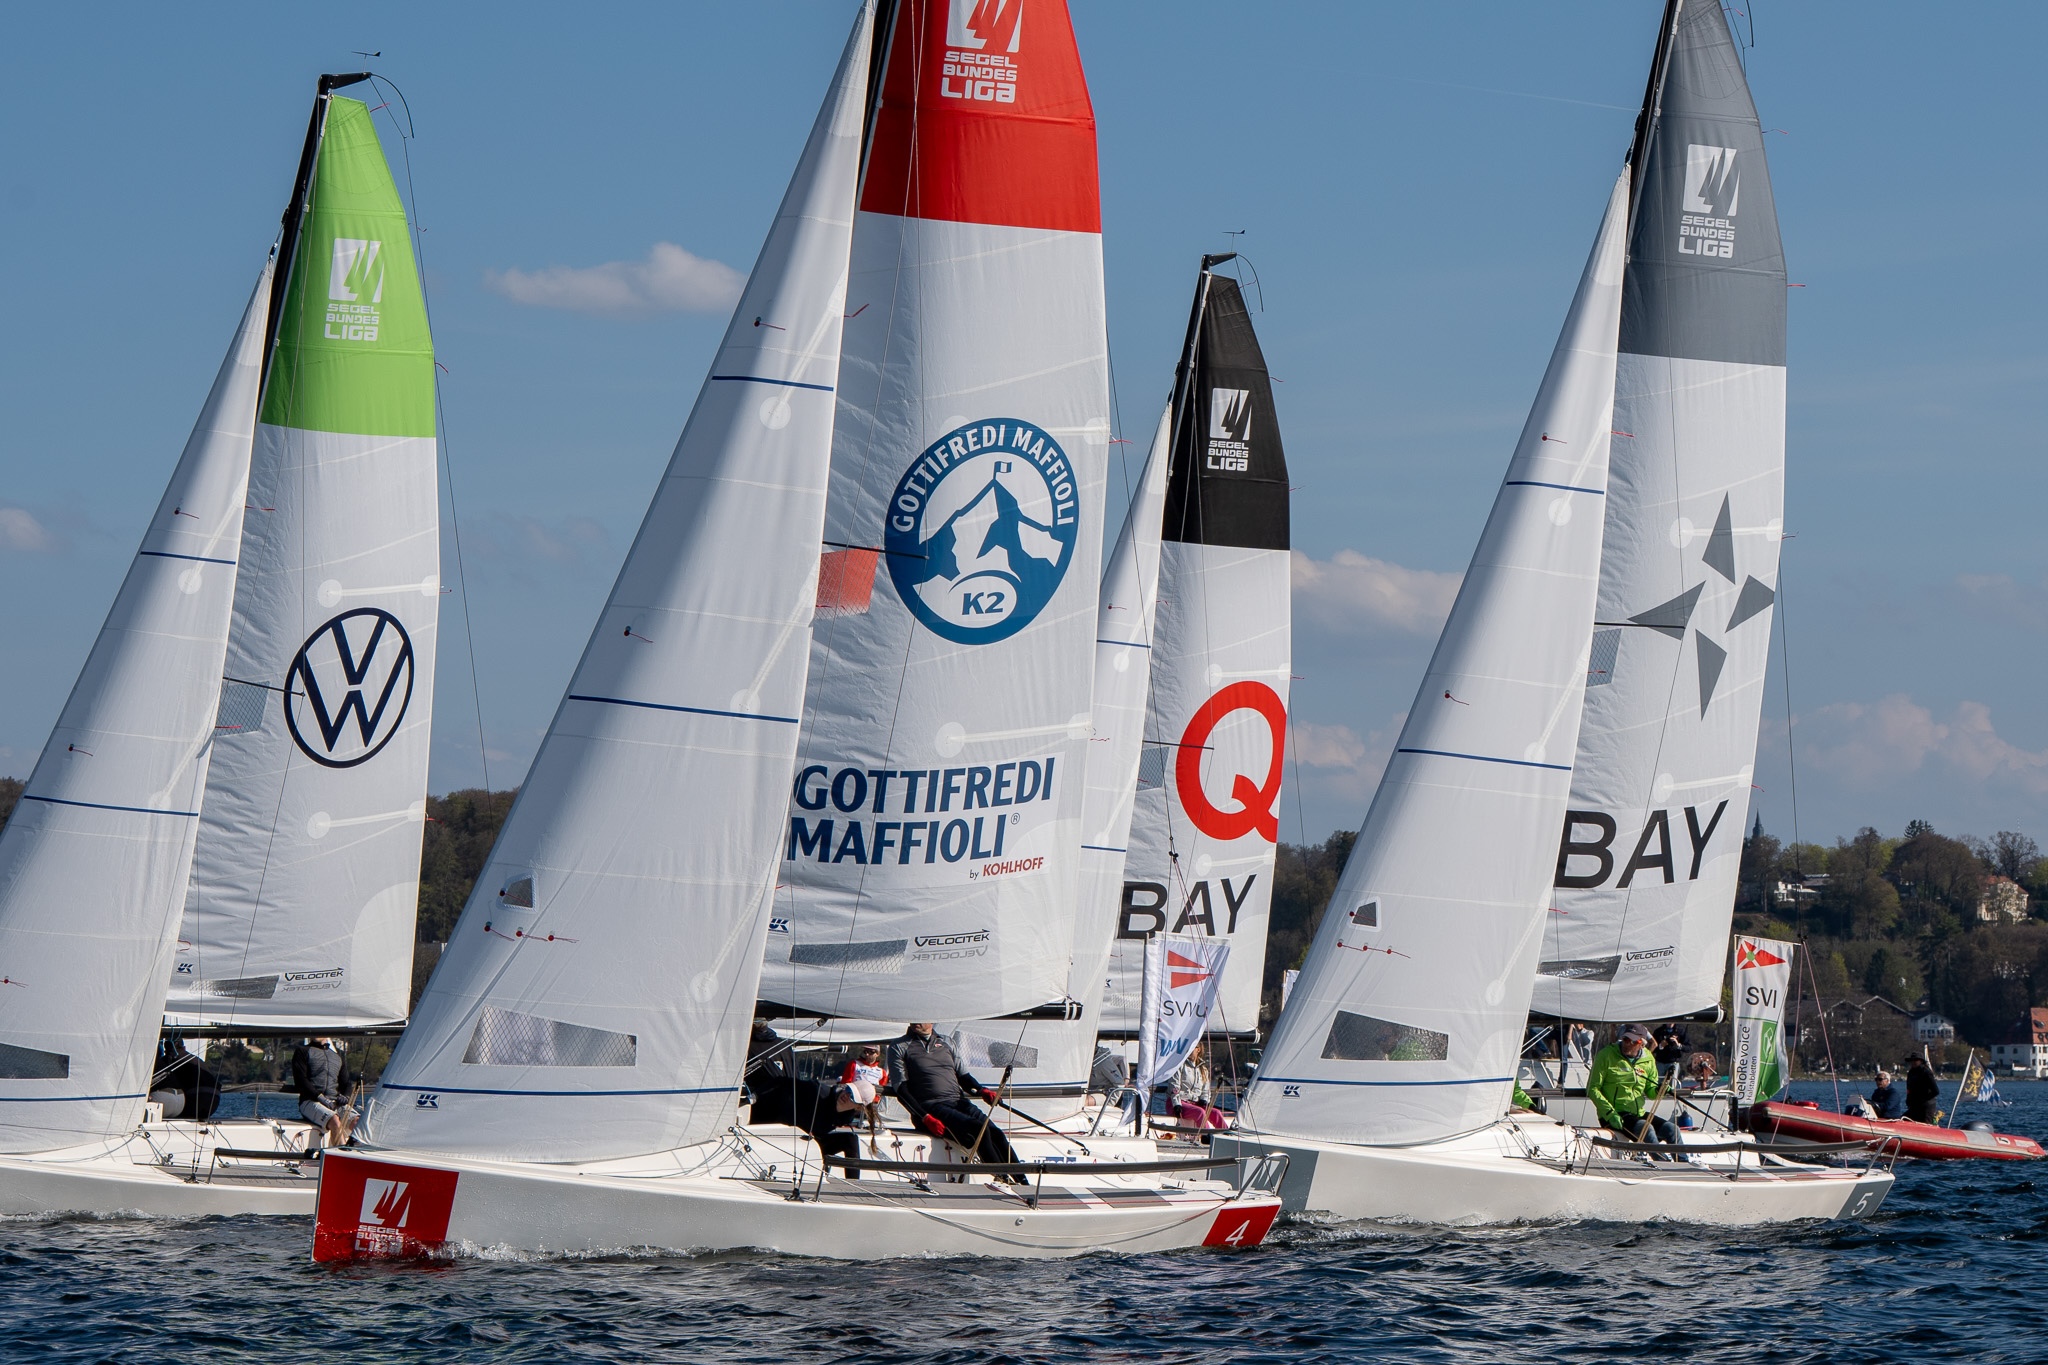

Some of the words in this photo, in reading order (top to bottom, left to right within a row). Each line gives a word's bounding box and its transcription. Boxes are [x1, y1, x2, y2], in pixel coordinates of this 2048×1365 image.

[944, 51, 1018, 69] SEGEL
[943, 63, 1018, 82] BUNDES
[1680, 225, 1735, 241] BUNDES
[1681, 214, 1736, 229] SEGEL
[326, 313, 380, 325] BUNDES
[327, 303, 380, 314] SEGEL
[1208, 448, 1249, 458] BUNDES
[1209, 440, 1249, 450] SEGEL
[892, 424, 1006, 533] GOTTIFREDI
[1011, 426, 1074, 526] MAFFIOLI
[961, 591, 1006, 616] K2
[1175, 680, 1287, 843] Q
[793, 757, 1056, 814] GOTTIFREDI
[1553, 799, 1730, 889] BAY
[969, 869, 979, 881] by
[982, 857, 1044, 877] KOHLHOFF
[1117, 873, 1257, 940] BAY
[1746, 986, 1778, 1009] SVI
[1851, 1192, 1874, 1216] 5
[358, 1224, 405, 1236] SEGEL
[1224, 1219, 1251, 1246] 4
